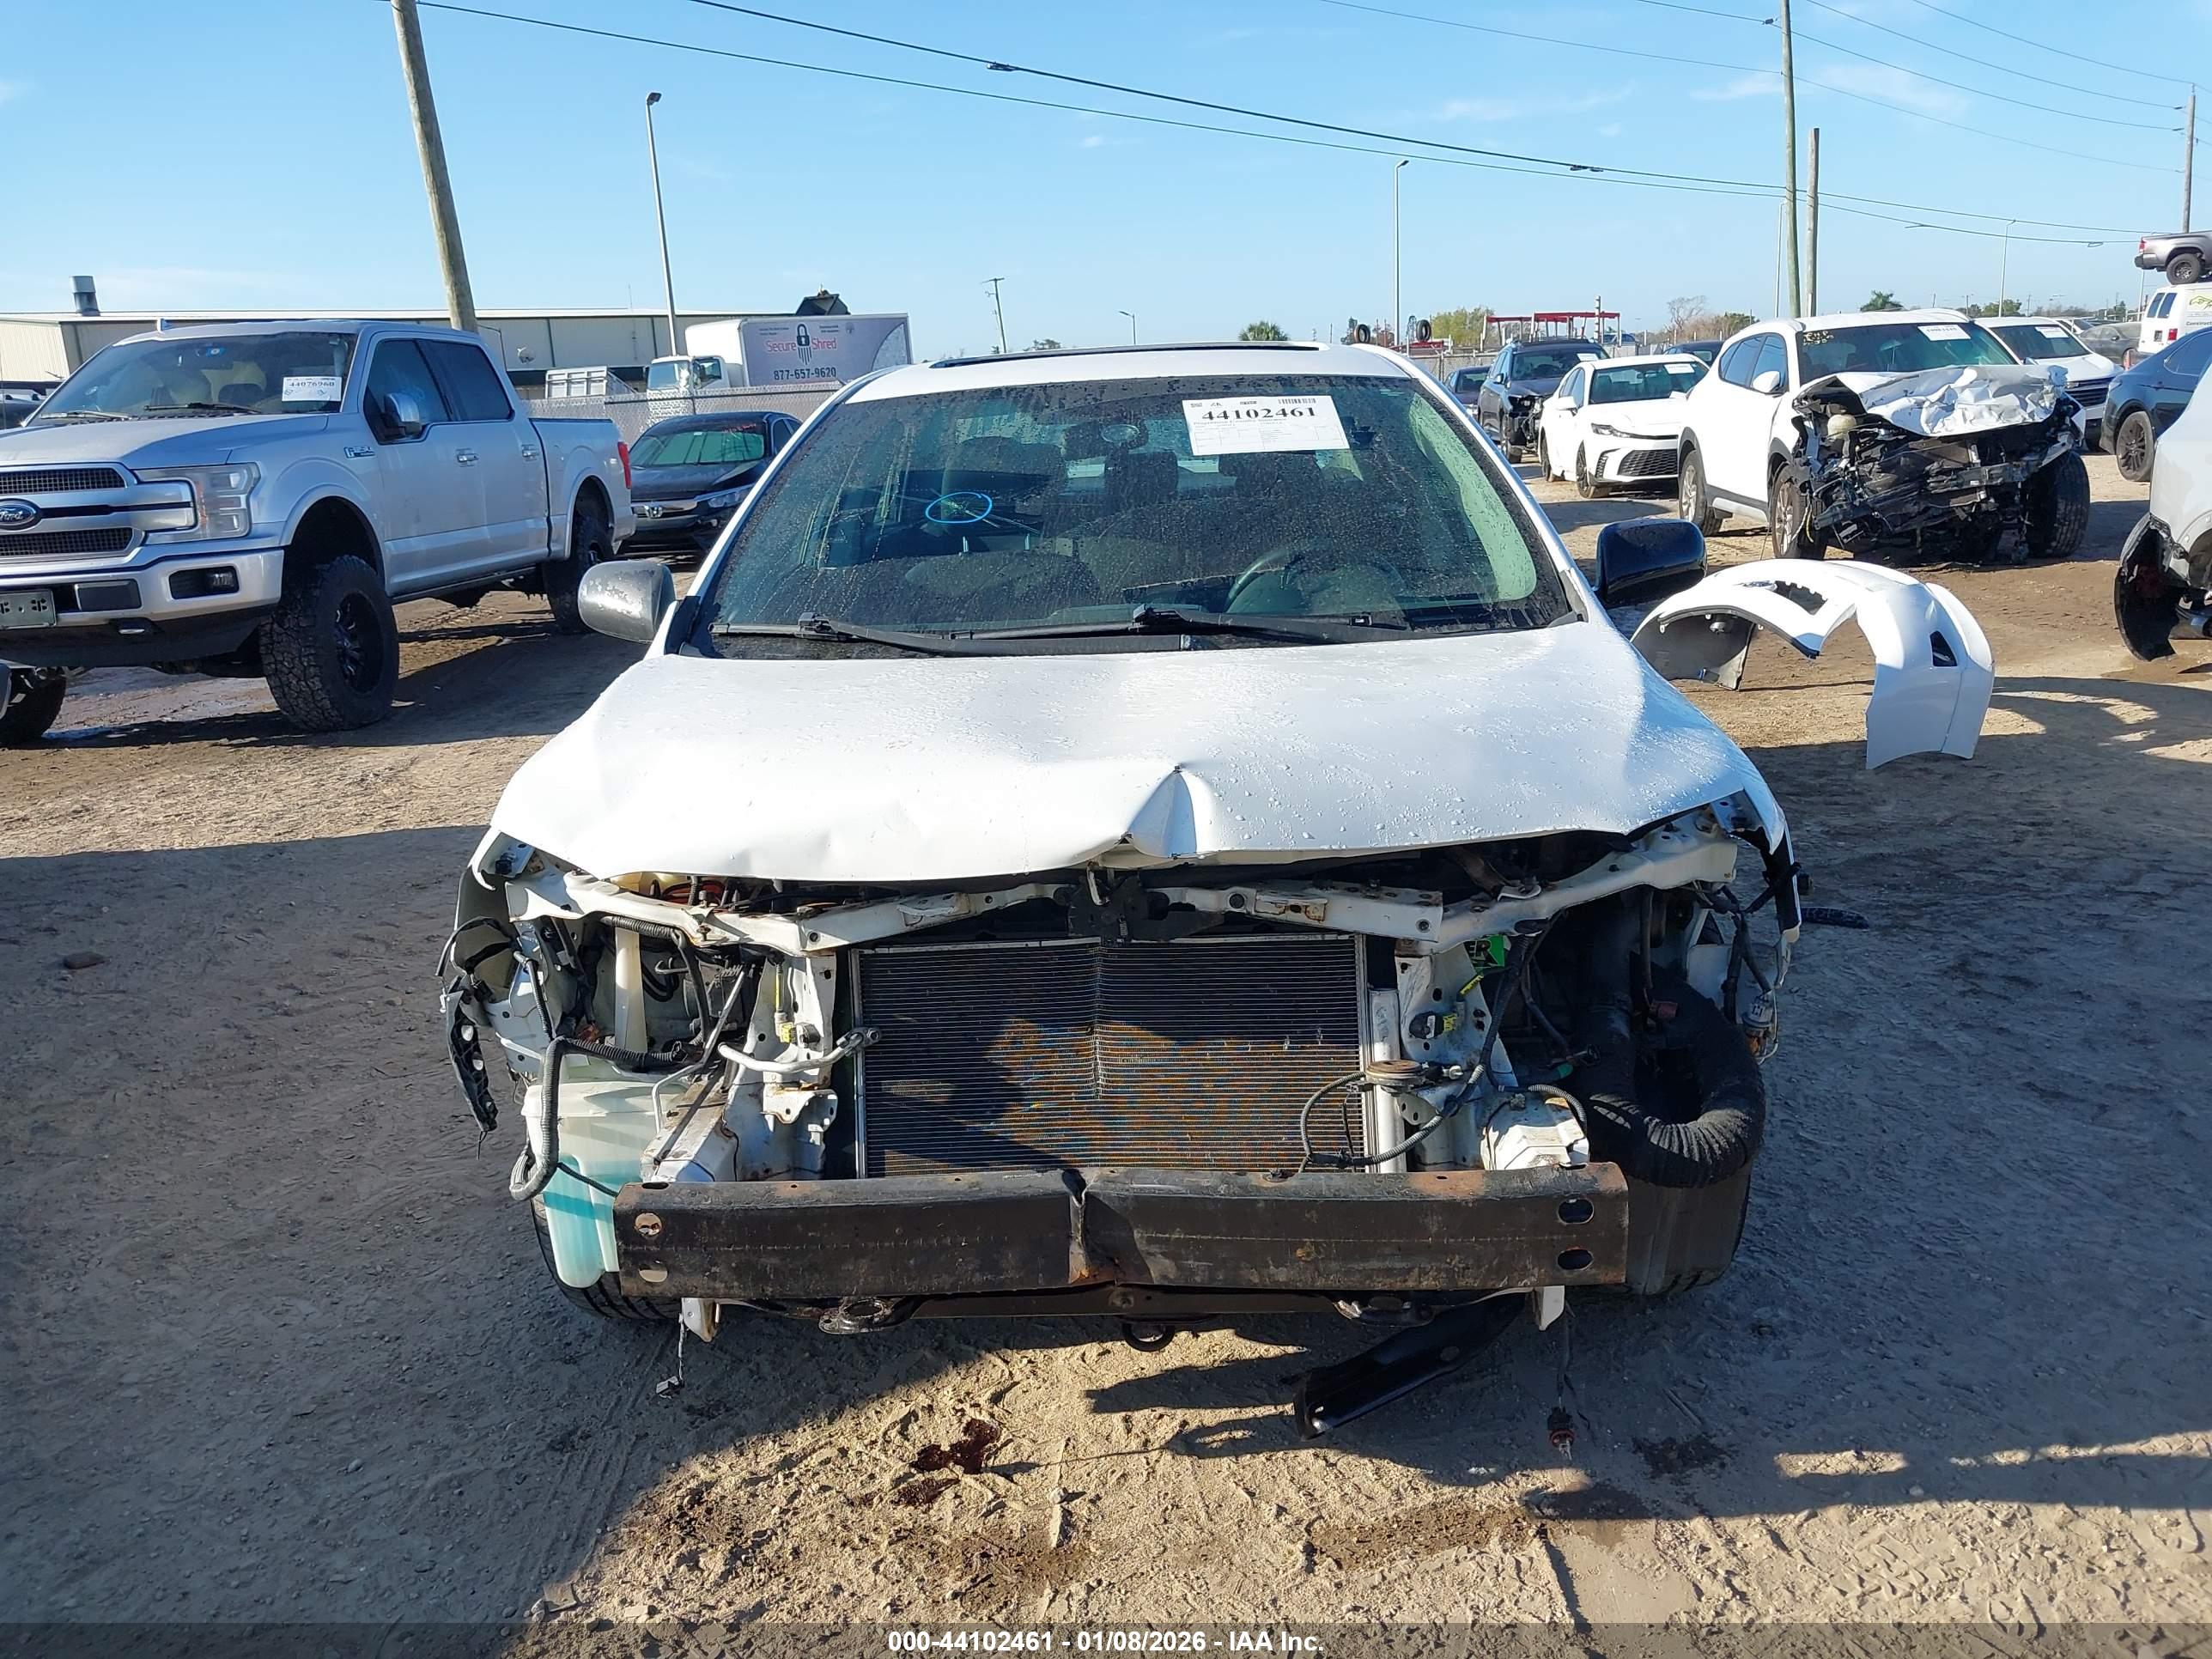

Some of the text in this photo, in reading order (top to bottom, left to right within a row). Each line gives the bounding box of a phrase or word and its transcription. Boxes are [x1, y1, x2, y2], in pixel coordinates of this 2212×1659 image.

[766, 337, 837, 352] Secure Shred
[773, 367, 836, 380] 877-657-9620
[1201, 406, 1318, 422] 44102461
